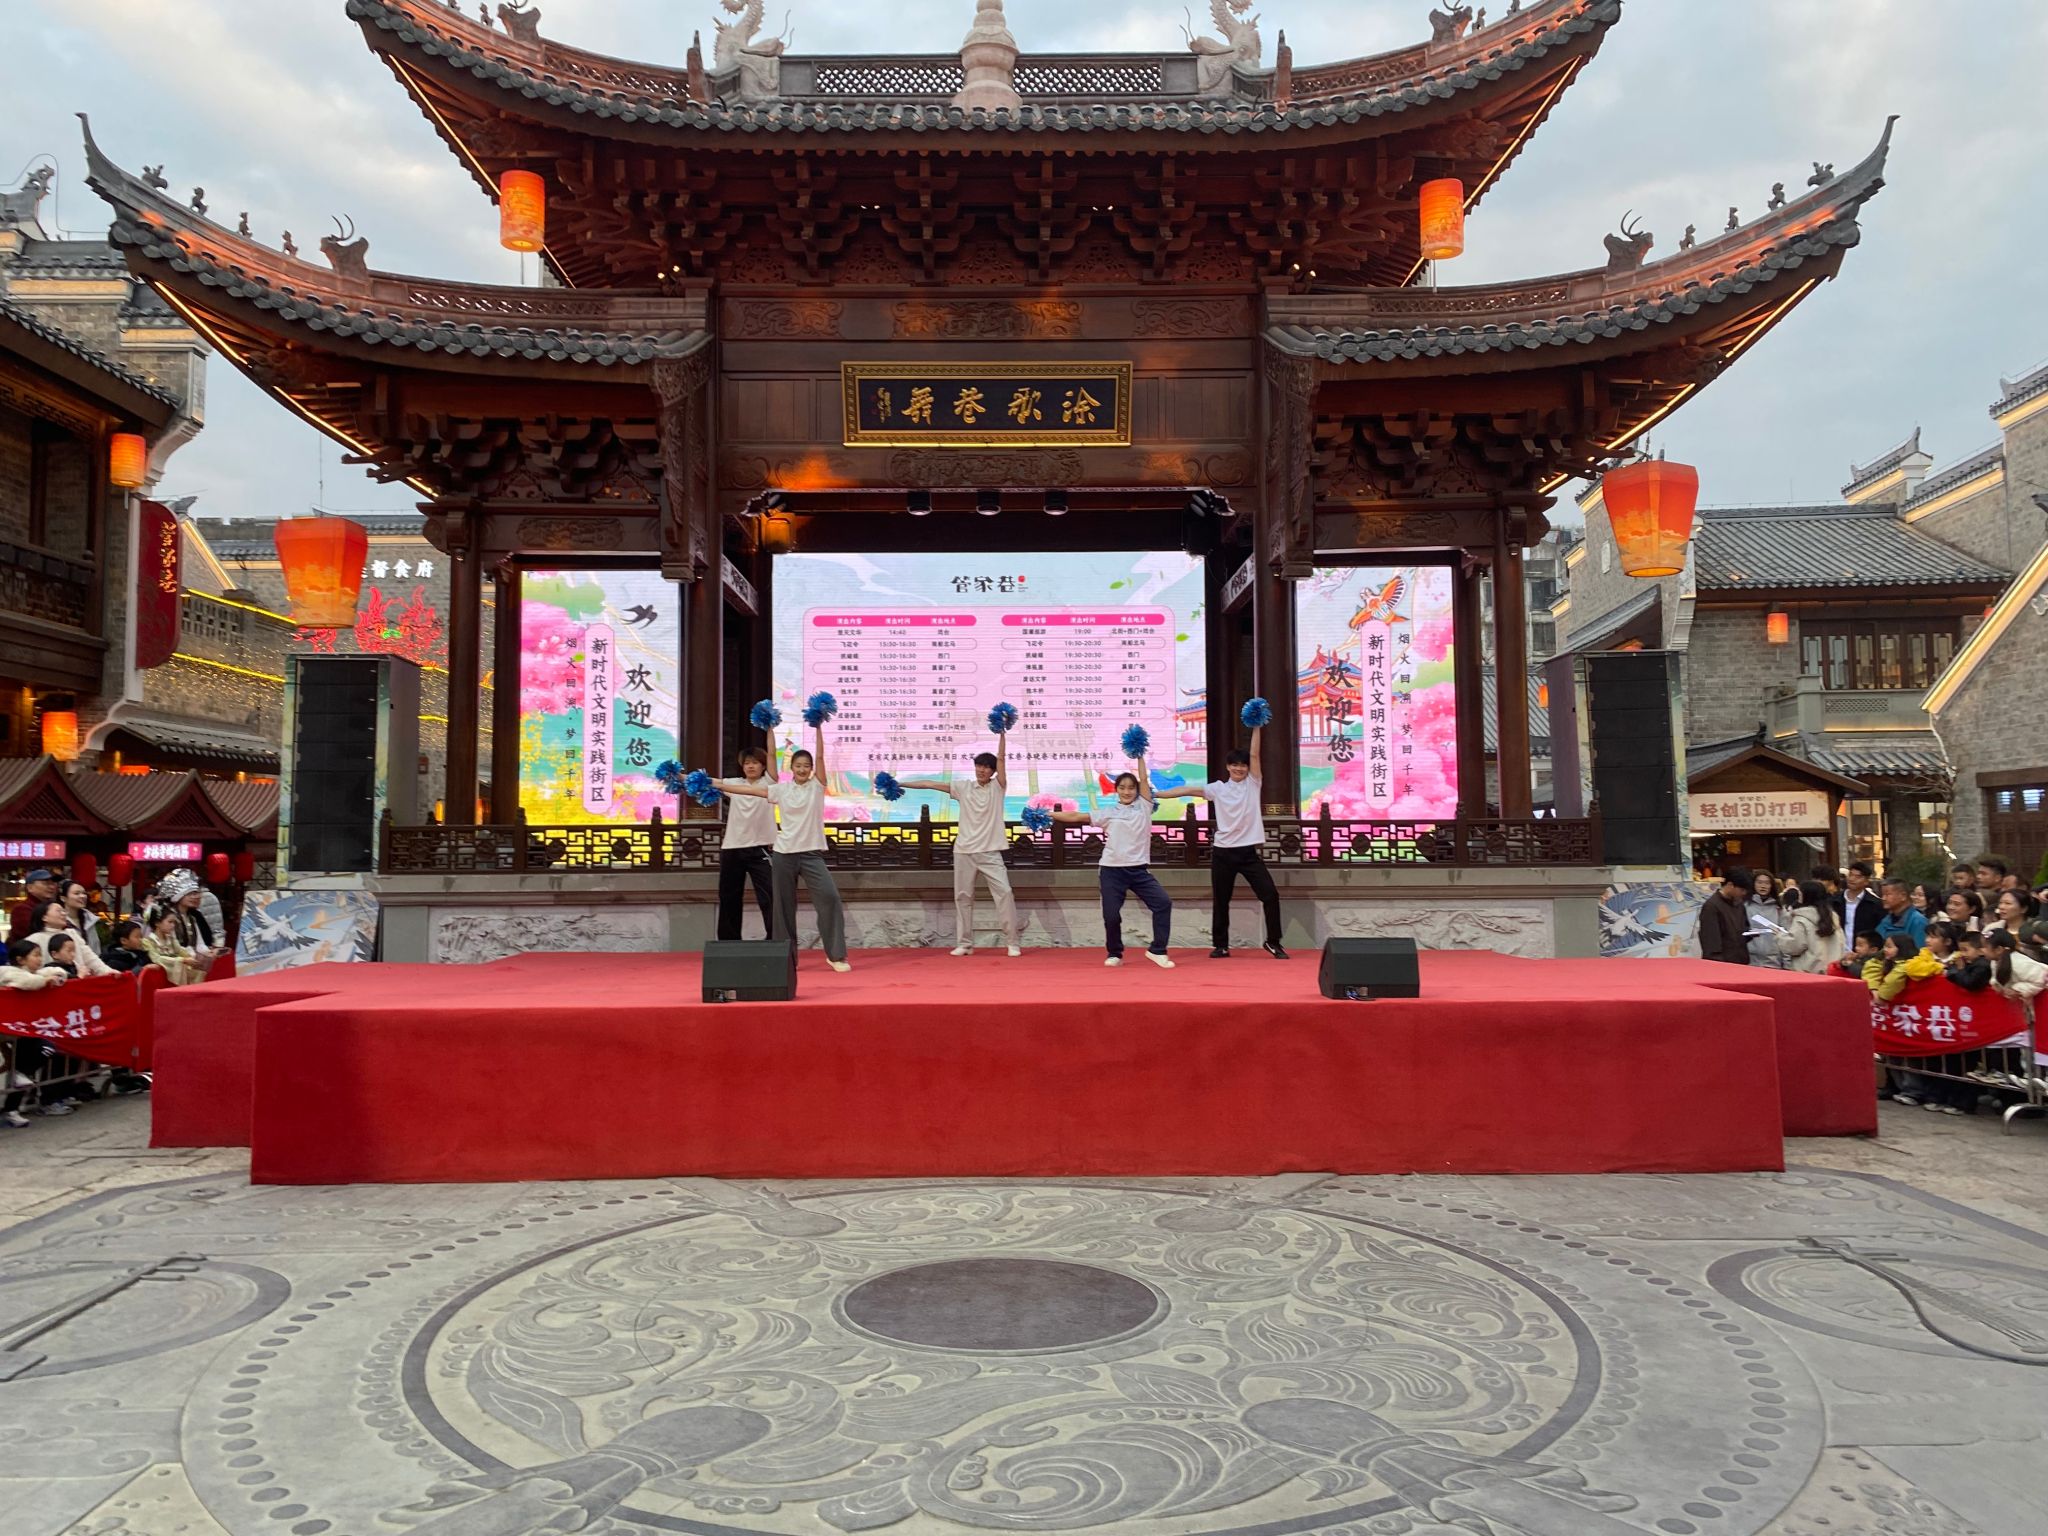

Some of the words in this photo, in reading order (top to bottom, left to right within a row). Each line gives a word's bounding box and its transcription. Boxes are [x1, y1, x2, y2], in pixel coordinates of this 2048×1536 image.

[951, 575, 1015, 593] 管家巷
[590, 638, 608, 802] 新时代文明实践街区
[625, 663, 655, 767] 欢迎您
[1326, 660, 1355, 763] 欢迎您
[1368, 634, 1388, 798] 新时代文明实践街区
[1700, 801, 1808, 818] 轻创3D打印
